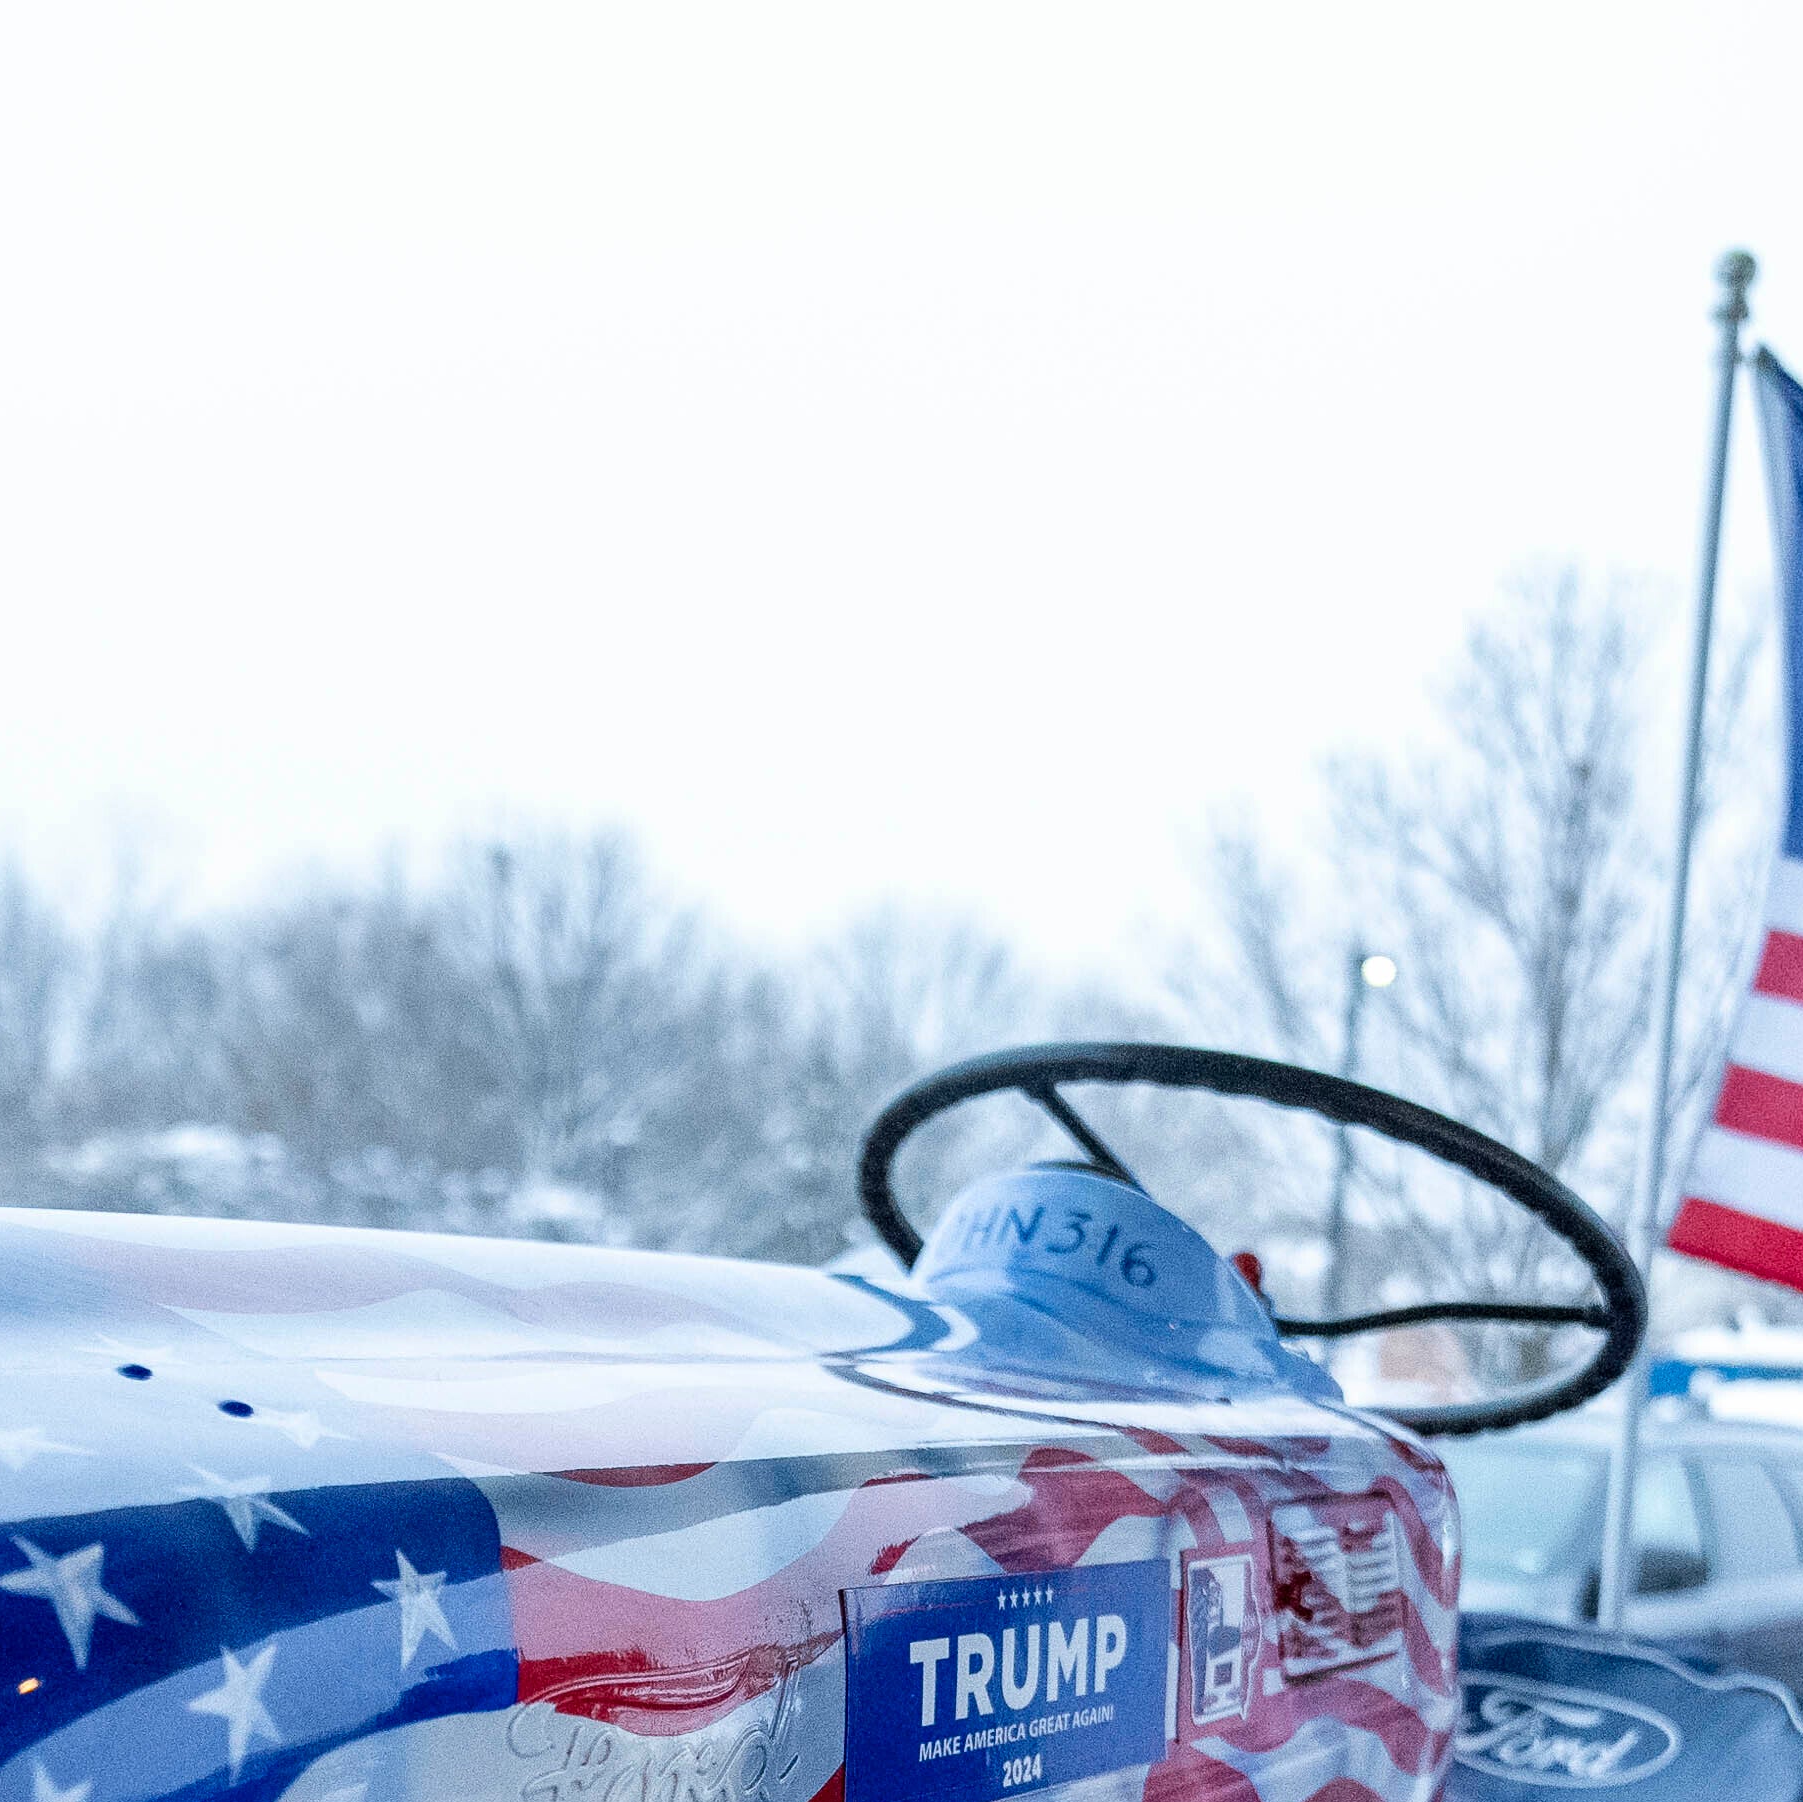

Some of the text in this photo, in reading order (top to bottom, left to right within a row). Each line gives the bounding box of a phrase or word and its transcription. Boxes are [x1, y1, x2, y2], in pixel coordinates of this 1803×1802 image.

[909, 1613, 1127, 1727] TRUMP
[918, 1704, 1115, 1763] MAKE AMERICA GREAT AGAIN!
[1002, 1752, 1043, 1788] 2024
[1454, 1688, 1641, 1778] Ford
